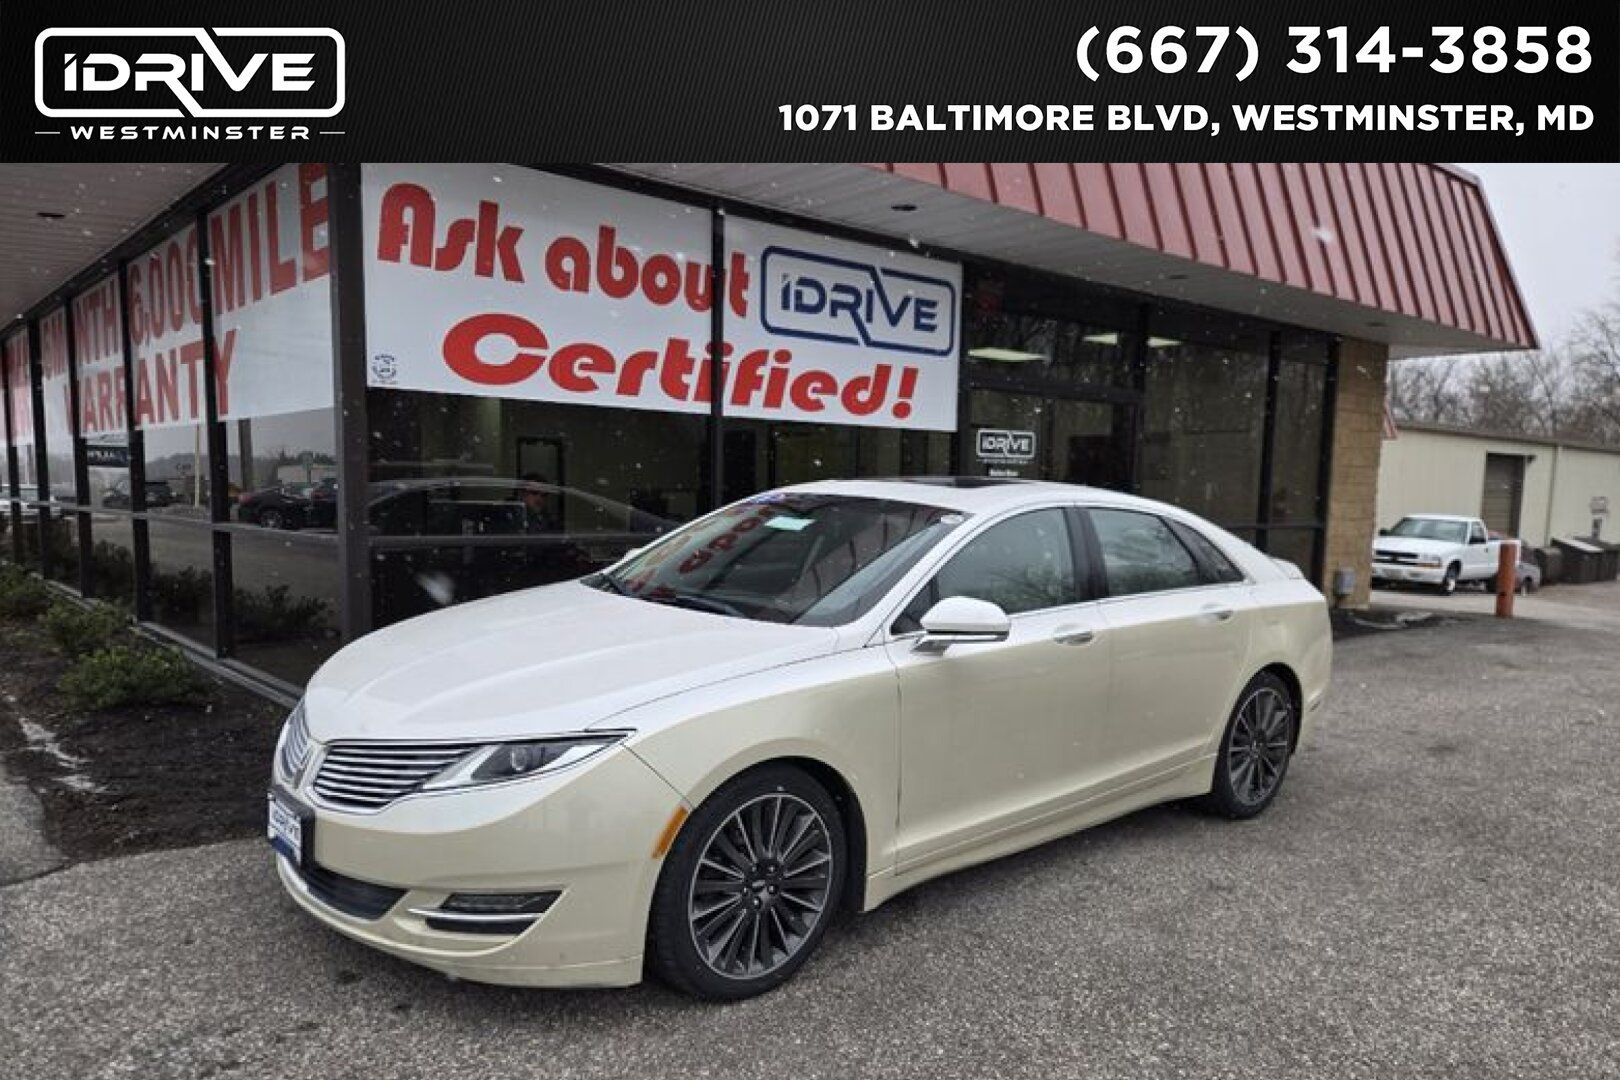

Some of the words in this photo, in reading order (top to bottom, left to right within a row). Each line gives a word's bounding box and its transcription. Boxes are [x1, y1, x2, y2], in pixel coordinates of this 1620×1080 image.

[377, 182, 525, 284] Ask
[545, 224, 750, 318] about
[443, 312, 919, 420] Certified!
